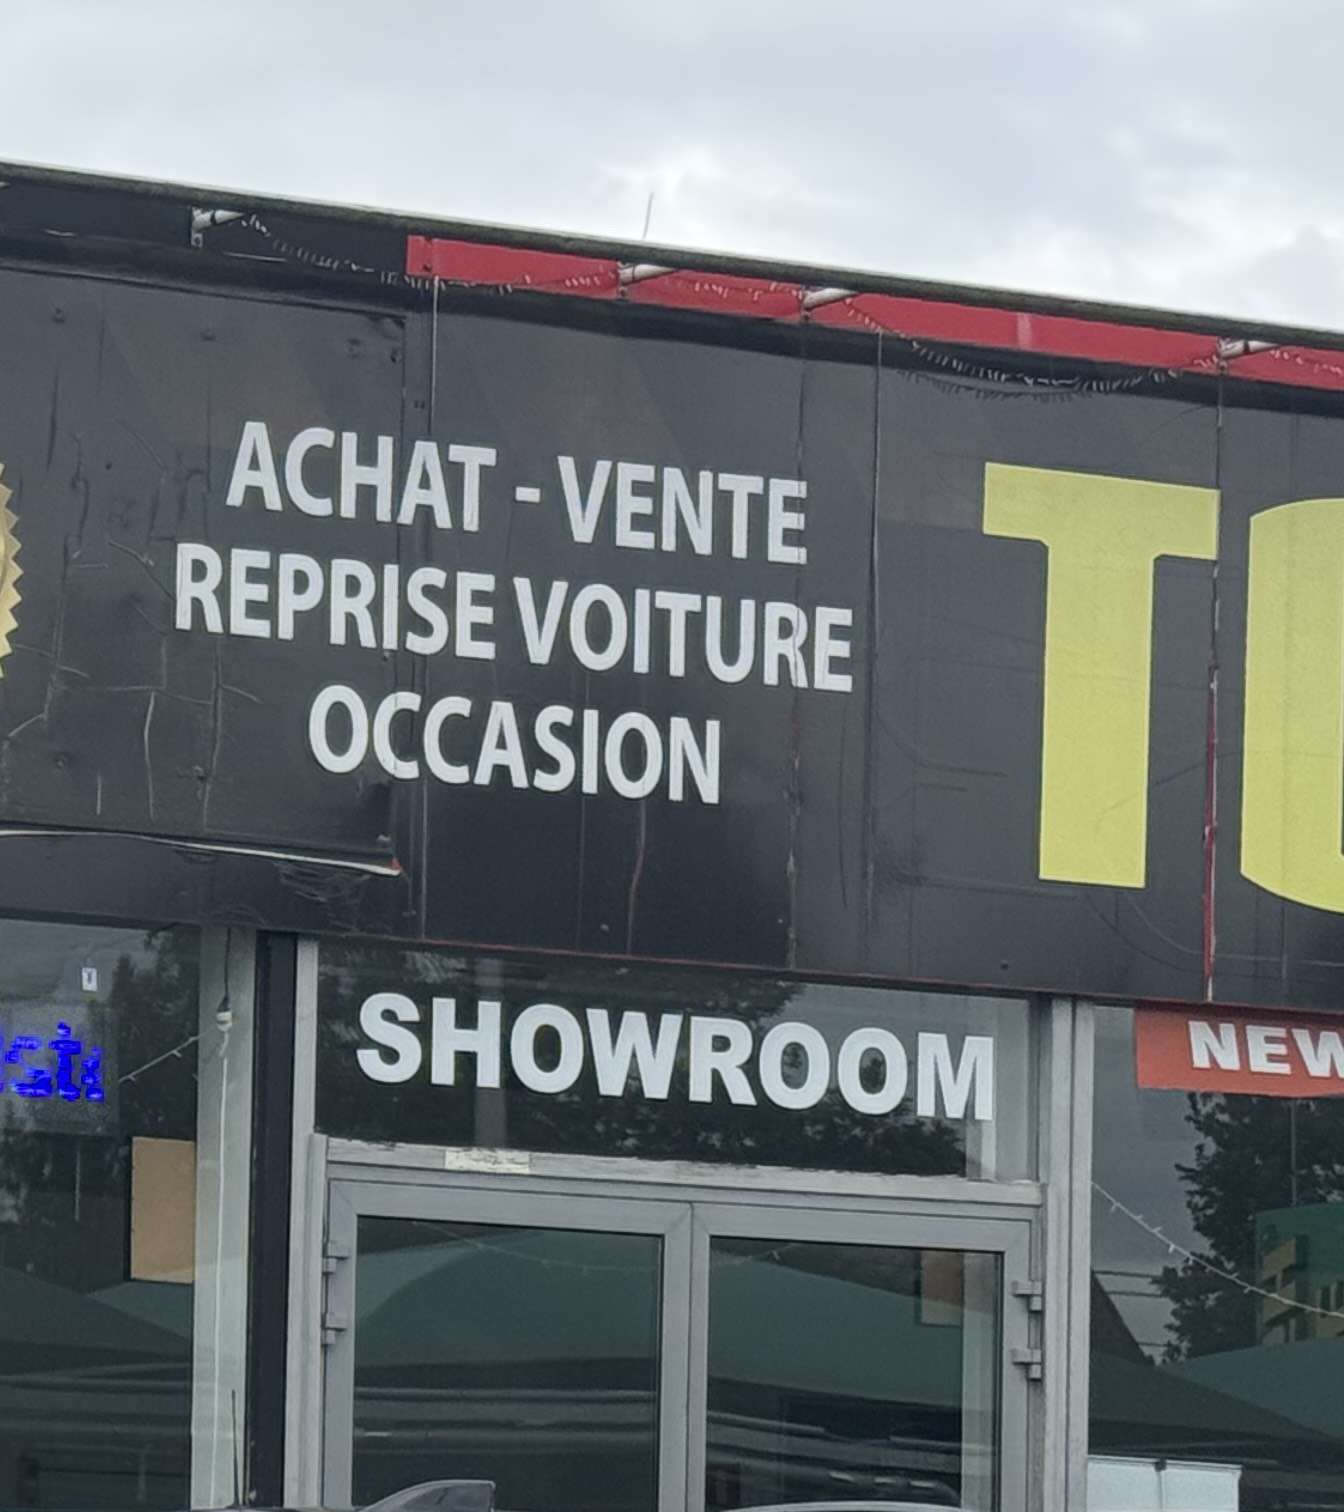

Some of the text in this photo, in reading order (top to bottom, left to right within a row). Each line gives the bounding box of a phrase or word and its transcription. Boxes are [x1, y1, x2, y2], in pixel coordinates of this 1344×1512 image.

[226, 421, 497, 533] ACHAT
[557, 455, 808, 565] VENTE
[174, 543, 854, 693] REPRISE VOITURE
[309, 684, 720, 805] OCCASION
[356, 992, 994, 1121] SHOWROOM
